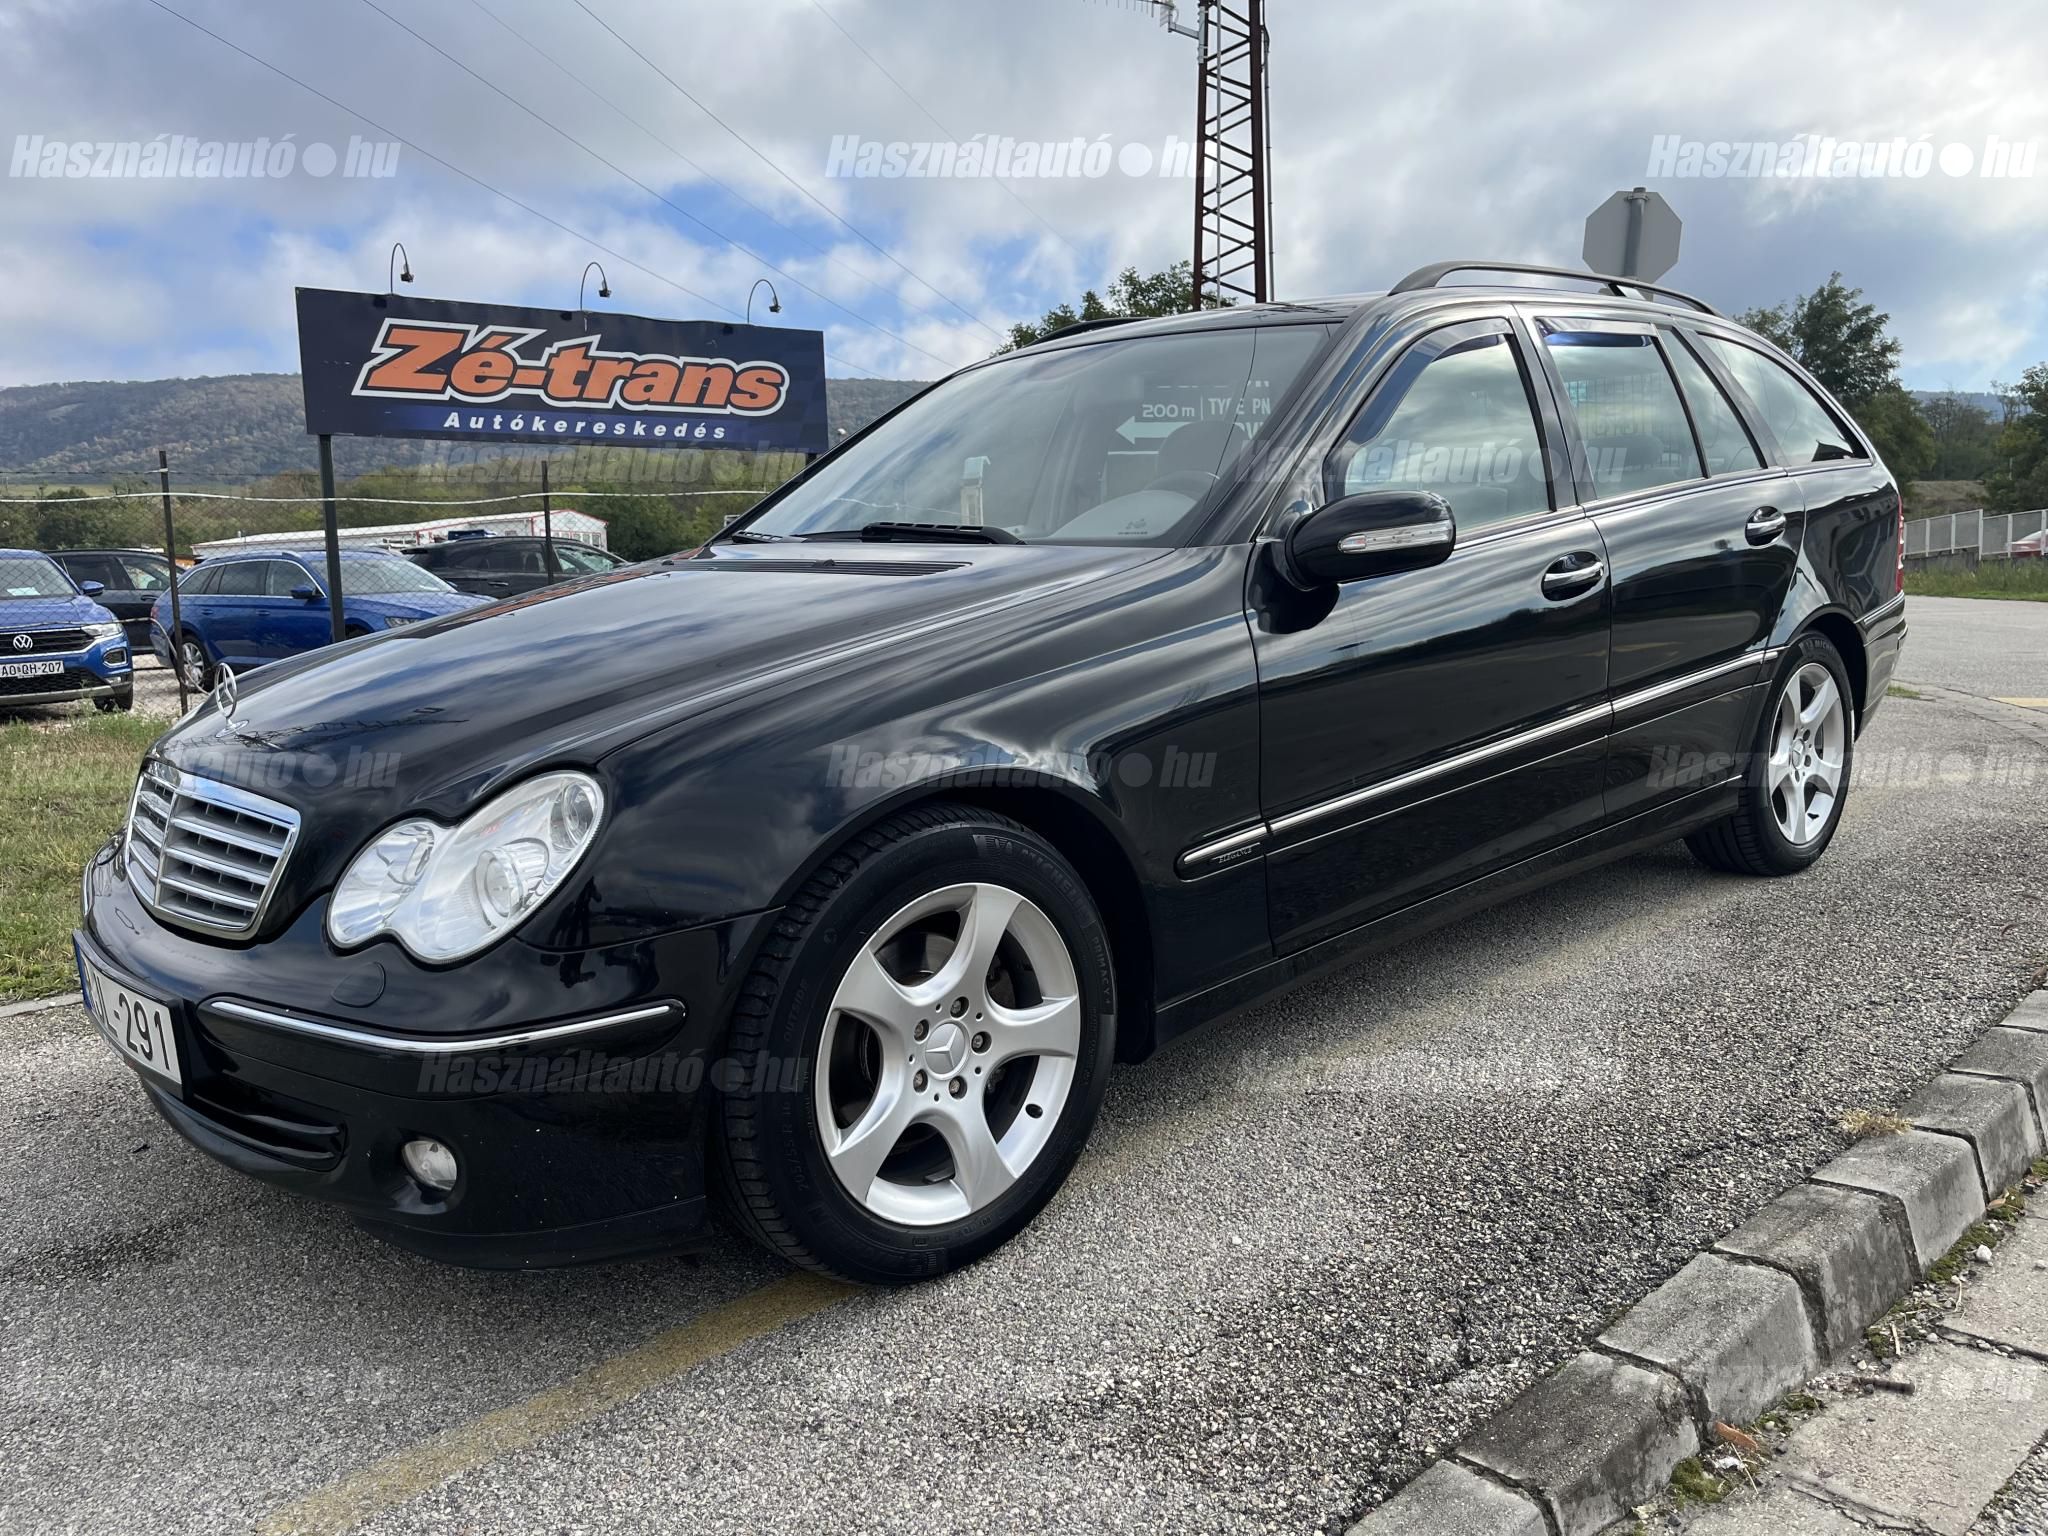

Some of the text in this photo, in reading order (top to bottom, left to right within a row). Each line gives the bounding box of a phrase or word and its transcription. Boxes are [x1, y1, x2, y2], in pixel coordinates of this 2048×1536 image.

[356, 319, 789, 414] Zé-trans
[443, 411, 727, 440] Autókereskedés
[1142, 404, 1195, 418] 200 m
